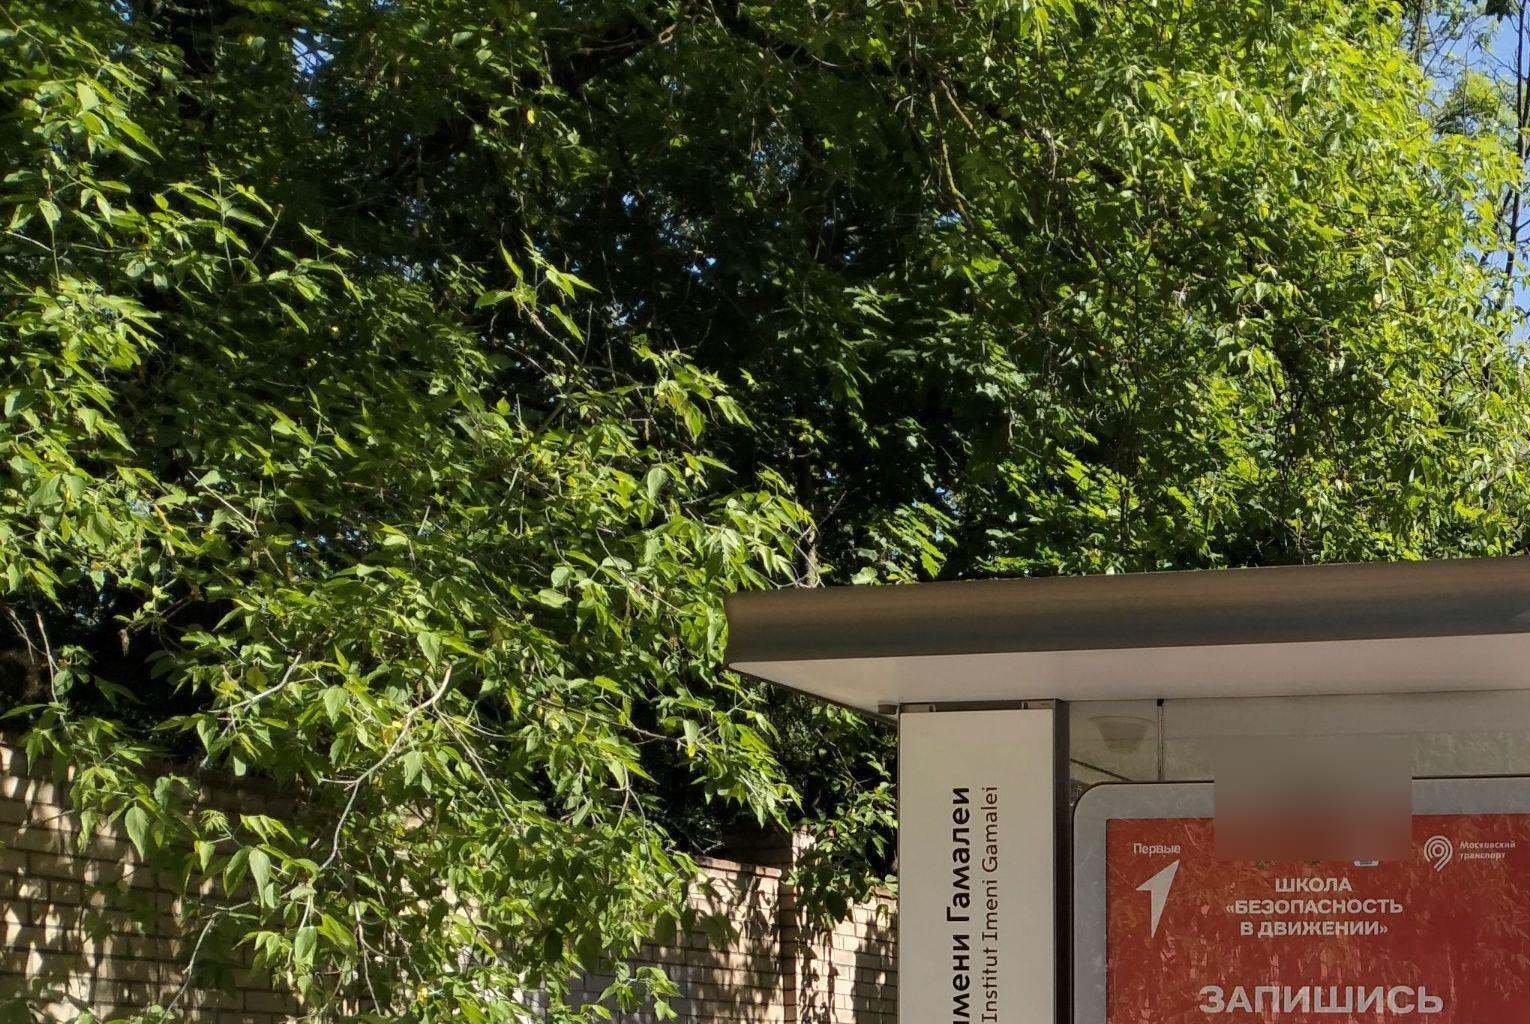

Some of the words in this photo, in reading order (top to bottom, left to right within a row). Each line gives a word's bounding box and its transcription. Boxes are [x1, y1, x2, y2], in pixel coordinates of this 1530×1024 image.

[981, 785, 998, 872] Gamalei
[1133, 843, 1181, 856] Первые
[1460, 841, 1516, 849] Московский
[946, 787, 971, 923] Гамалеи
[1460, 852, 1506, 861] транспорт
[1275, 877, 1352, 893] ШКОЛА
[981, 879, 998, 940] Imeni
[1225, 898, 1403, 915] «БЕЗОПАСНОСТЬ
[1240, 922, 1254, 936] В
[1257, 921, 1389, 938] ДВИЖЕНИИ»
[981, 942, 998, 1024] Institut
[1199, 985, 1444, 1014] ЗАПИШИСЬ
